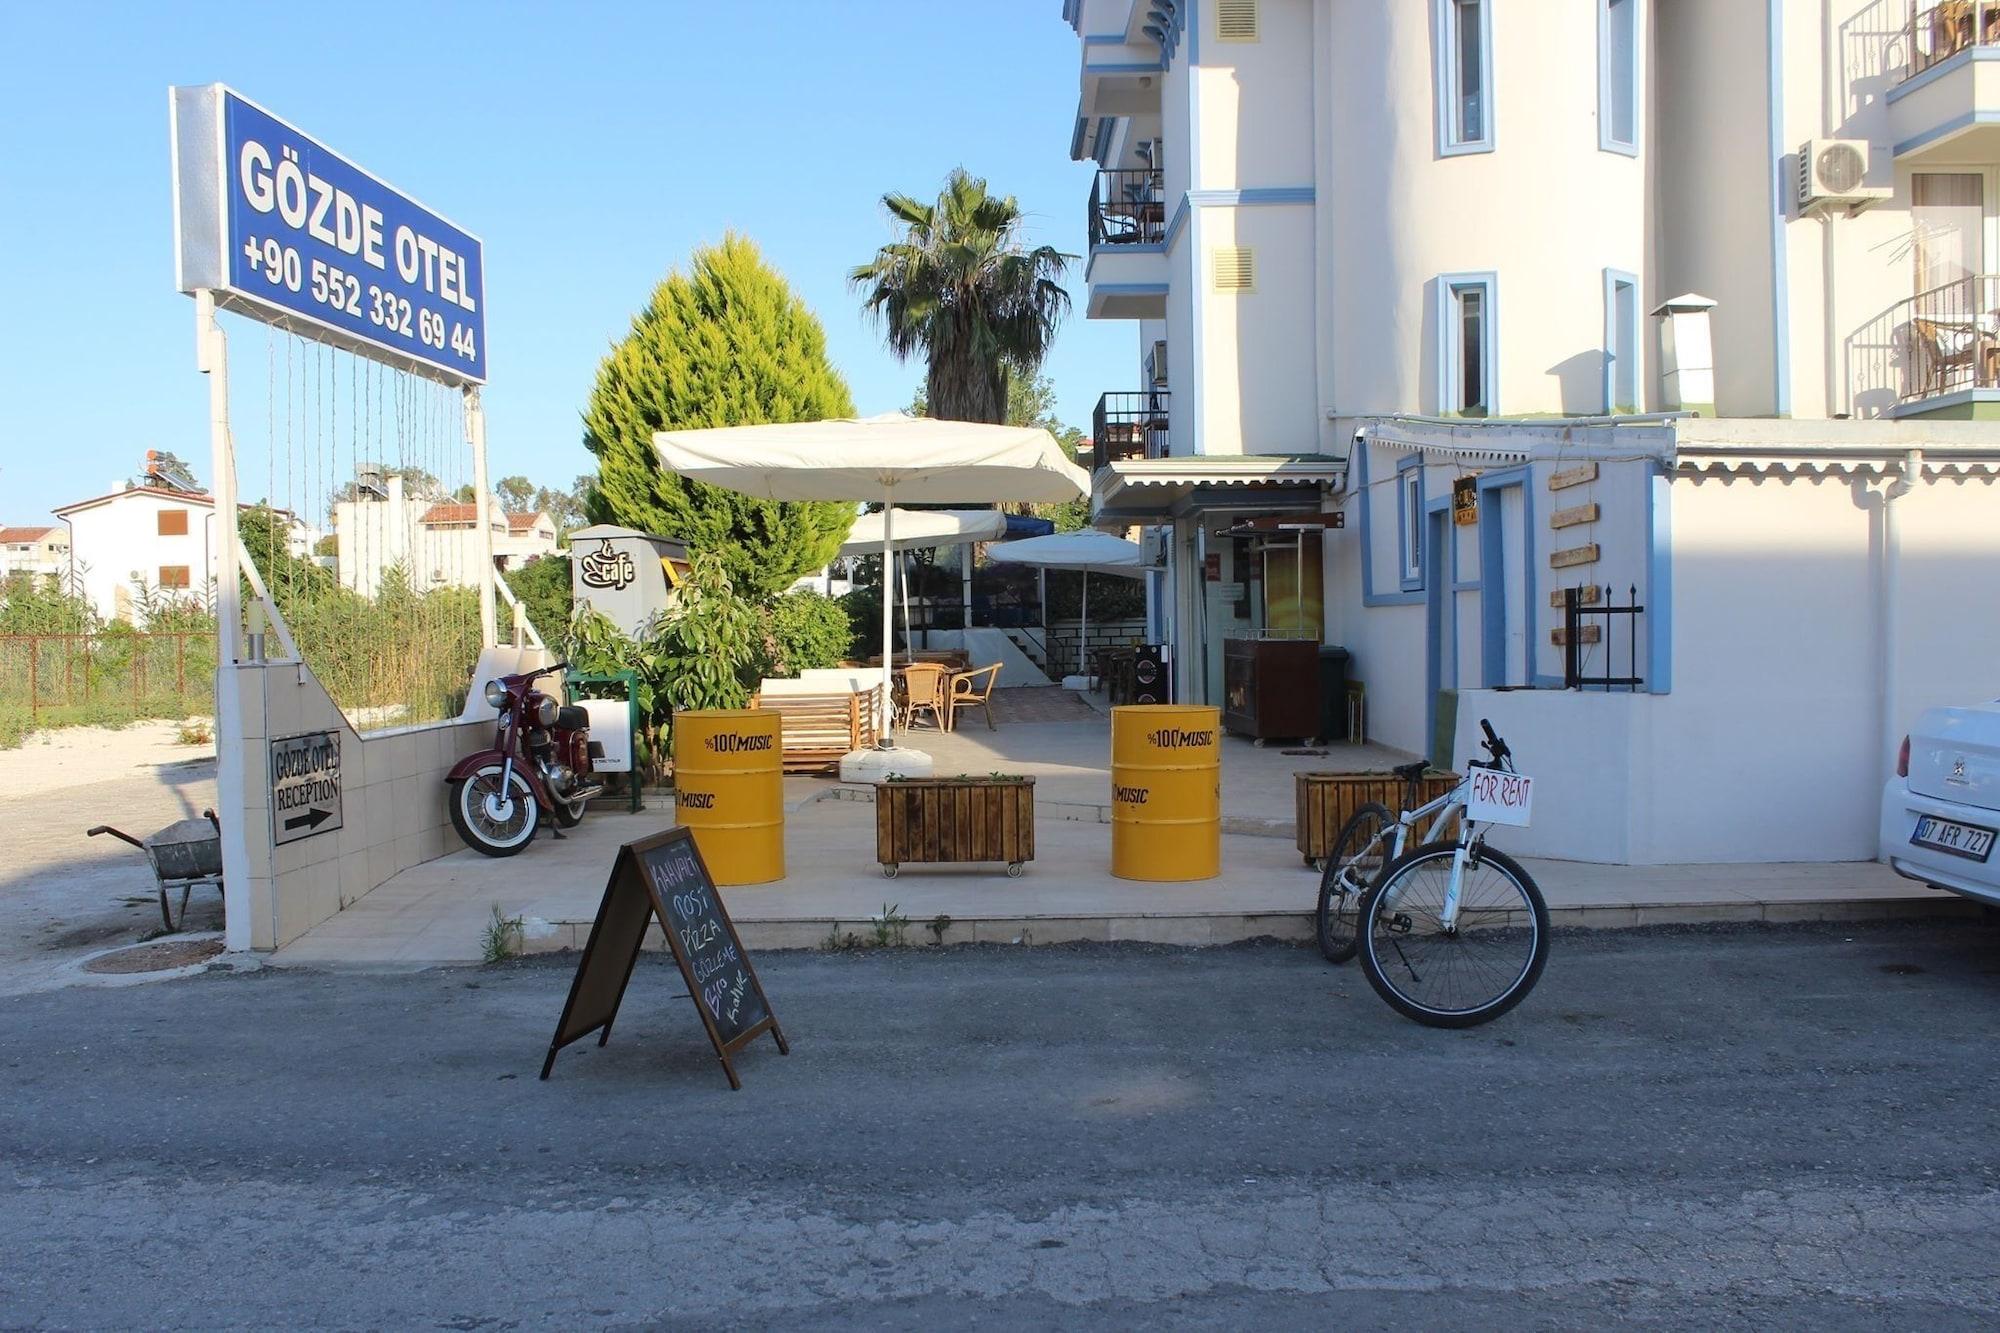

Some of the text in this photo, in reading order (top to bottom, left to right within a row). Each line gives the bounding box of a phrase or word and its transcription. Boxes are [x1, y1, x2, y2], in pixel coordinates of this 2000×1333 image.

[240, 140, 476, 313] GÖZDE OTEL
[245, 235, 476, 362] +90 552 332 69 44
[601, 551, 635, 589] cafe
[736, 734, 773, 752] MUSIC
[1179, 730, 1213, 748] MUSIC
[278, 777, 338, 811] RECEPTION
[681, 792, 715, 809] MUSIC
[1116, 786, 1149, 804] MUSIC
[1473, 772, 1530, 808] FOR RENT
[1921, 820, 1991, 853] 07 AFR 727
